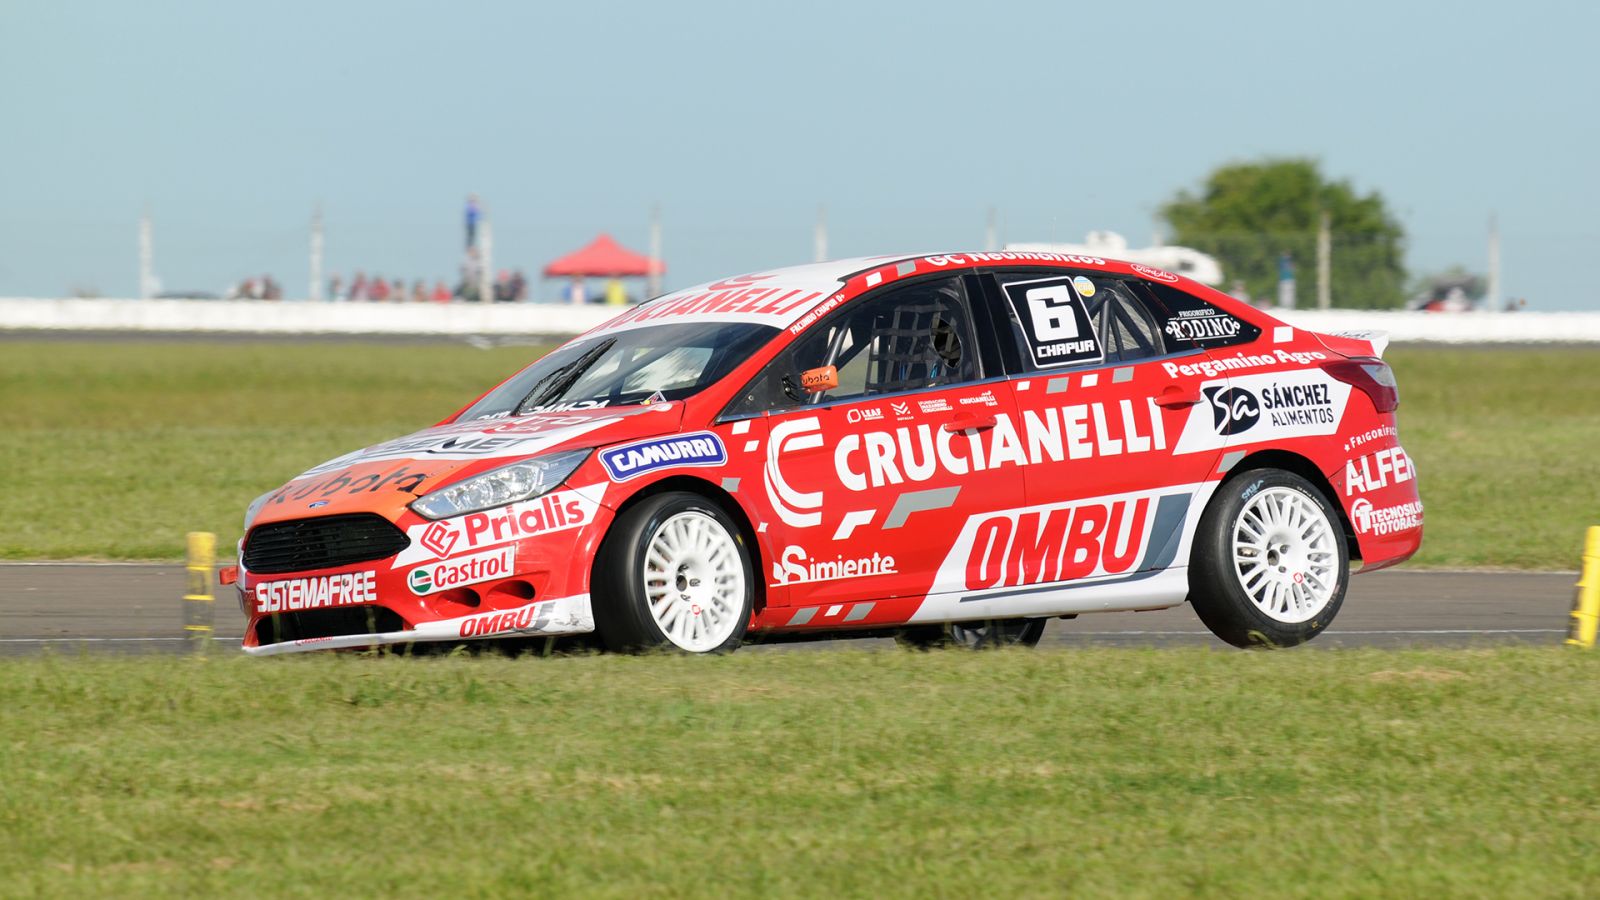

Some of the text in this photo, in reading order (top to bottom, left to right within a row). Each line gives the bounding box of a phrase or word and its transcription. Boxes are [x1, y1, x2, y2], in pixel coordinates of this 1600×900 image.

[924, 253, 965, 267] GC
[1025, 285, 1079, 342] 6
[1170, 317, 1236, 338] RODINO
[1036, 340, 1095, 358] CHAPUR
[1162, 349, 1327, 379] Pergamino Agro
[803, 373, 830, 384] ubota
[1262, 383, 1331, 409] SÁNCHEZ
[1271, 409, 1334, 427] ALIMENTOS
[611, 438, 718, 472] CAMURRI
[834, 397, 1166, 491] CRUCIANELLI
[464, 495, 585, 546] Prialis
[1372, 515, 1417, 536] TOTORAS
[965, 497, 1150, 592] OMBU
[434, 552, 509, 588] Castrol
[781, 545, 896, 582] Simiente
[256, 570, 377, 612] SISTEMAFREE
[459, 607, 536, 637] OMBU
